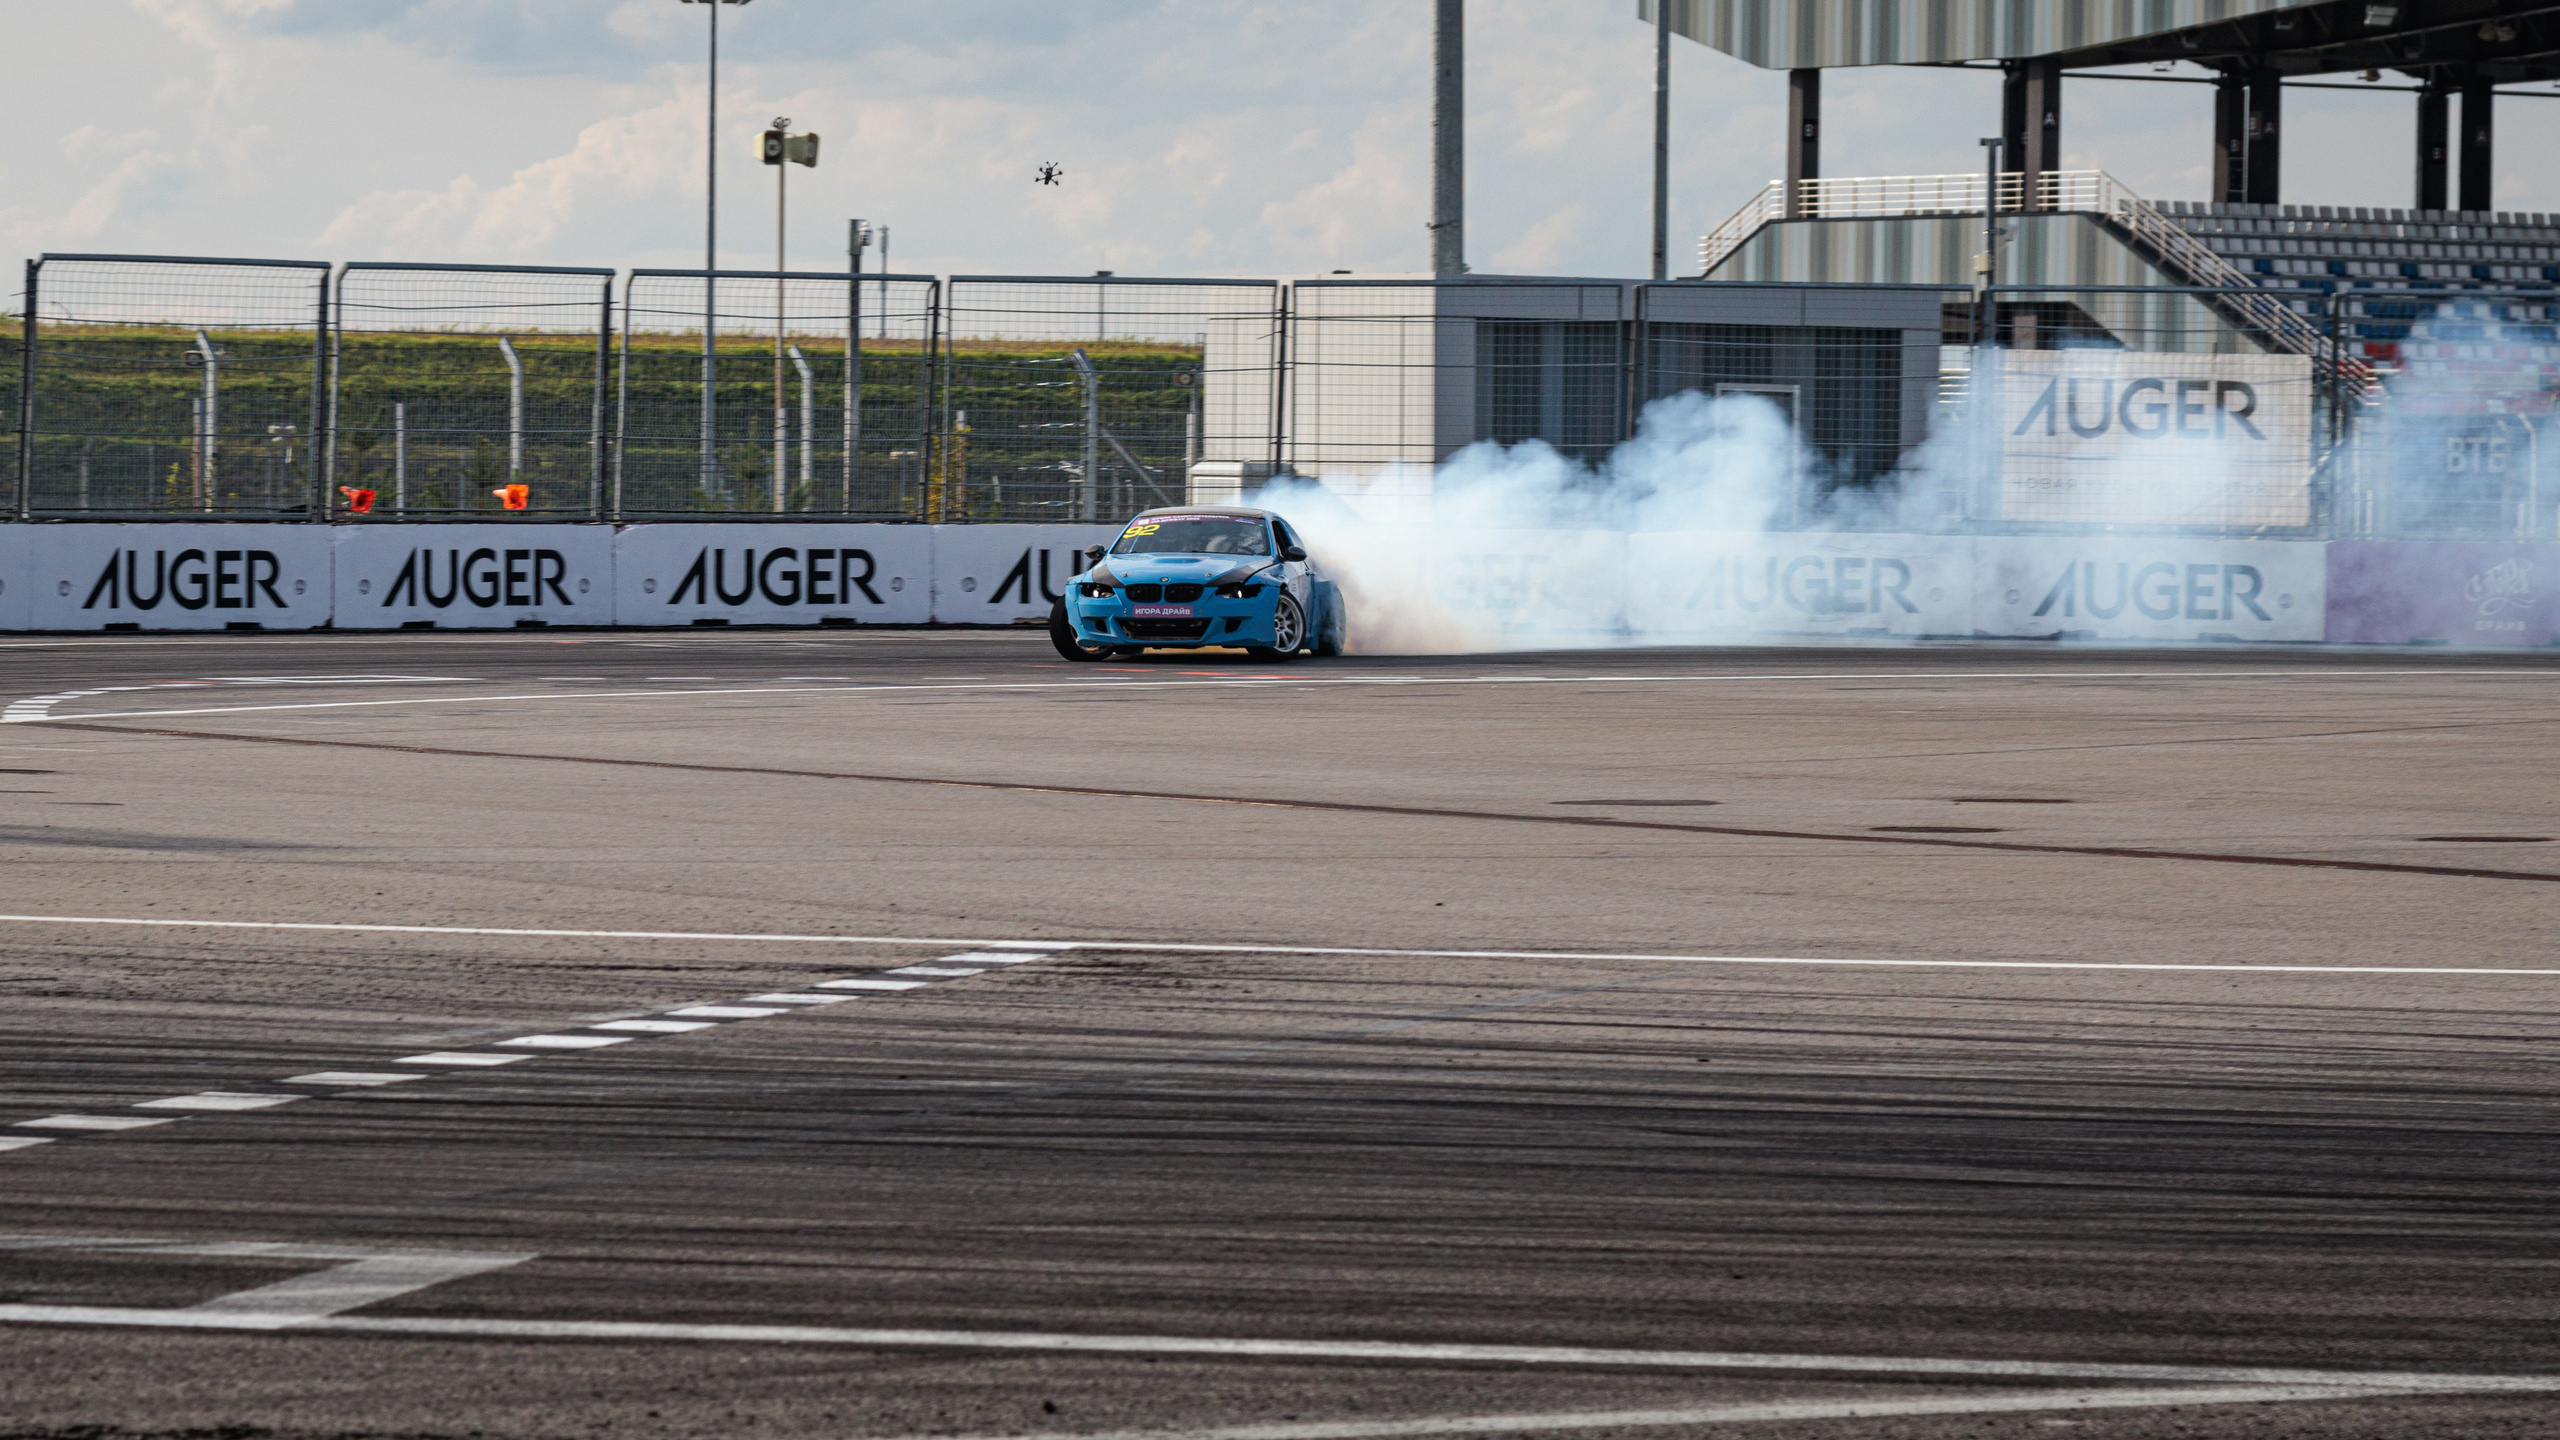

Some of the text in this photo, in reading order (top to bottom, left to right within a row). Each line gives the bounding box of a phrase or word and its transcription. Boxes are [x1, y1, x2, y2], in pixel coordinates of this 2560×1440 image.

[2012, 376, 2269, 441] AUGER
[1123, 524, 1161, 538] 92
[82, 547, 289, 611] AUGER
[381, 546, 574, 608] AUGER
[667, 545, 886, 607] AUGER
[1683, 554, 1921, 614] AUGER
[2033, 558, 2273, 622] AUGER
[1162, 607, 1191, 616] ДРАЙВ
